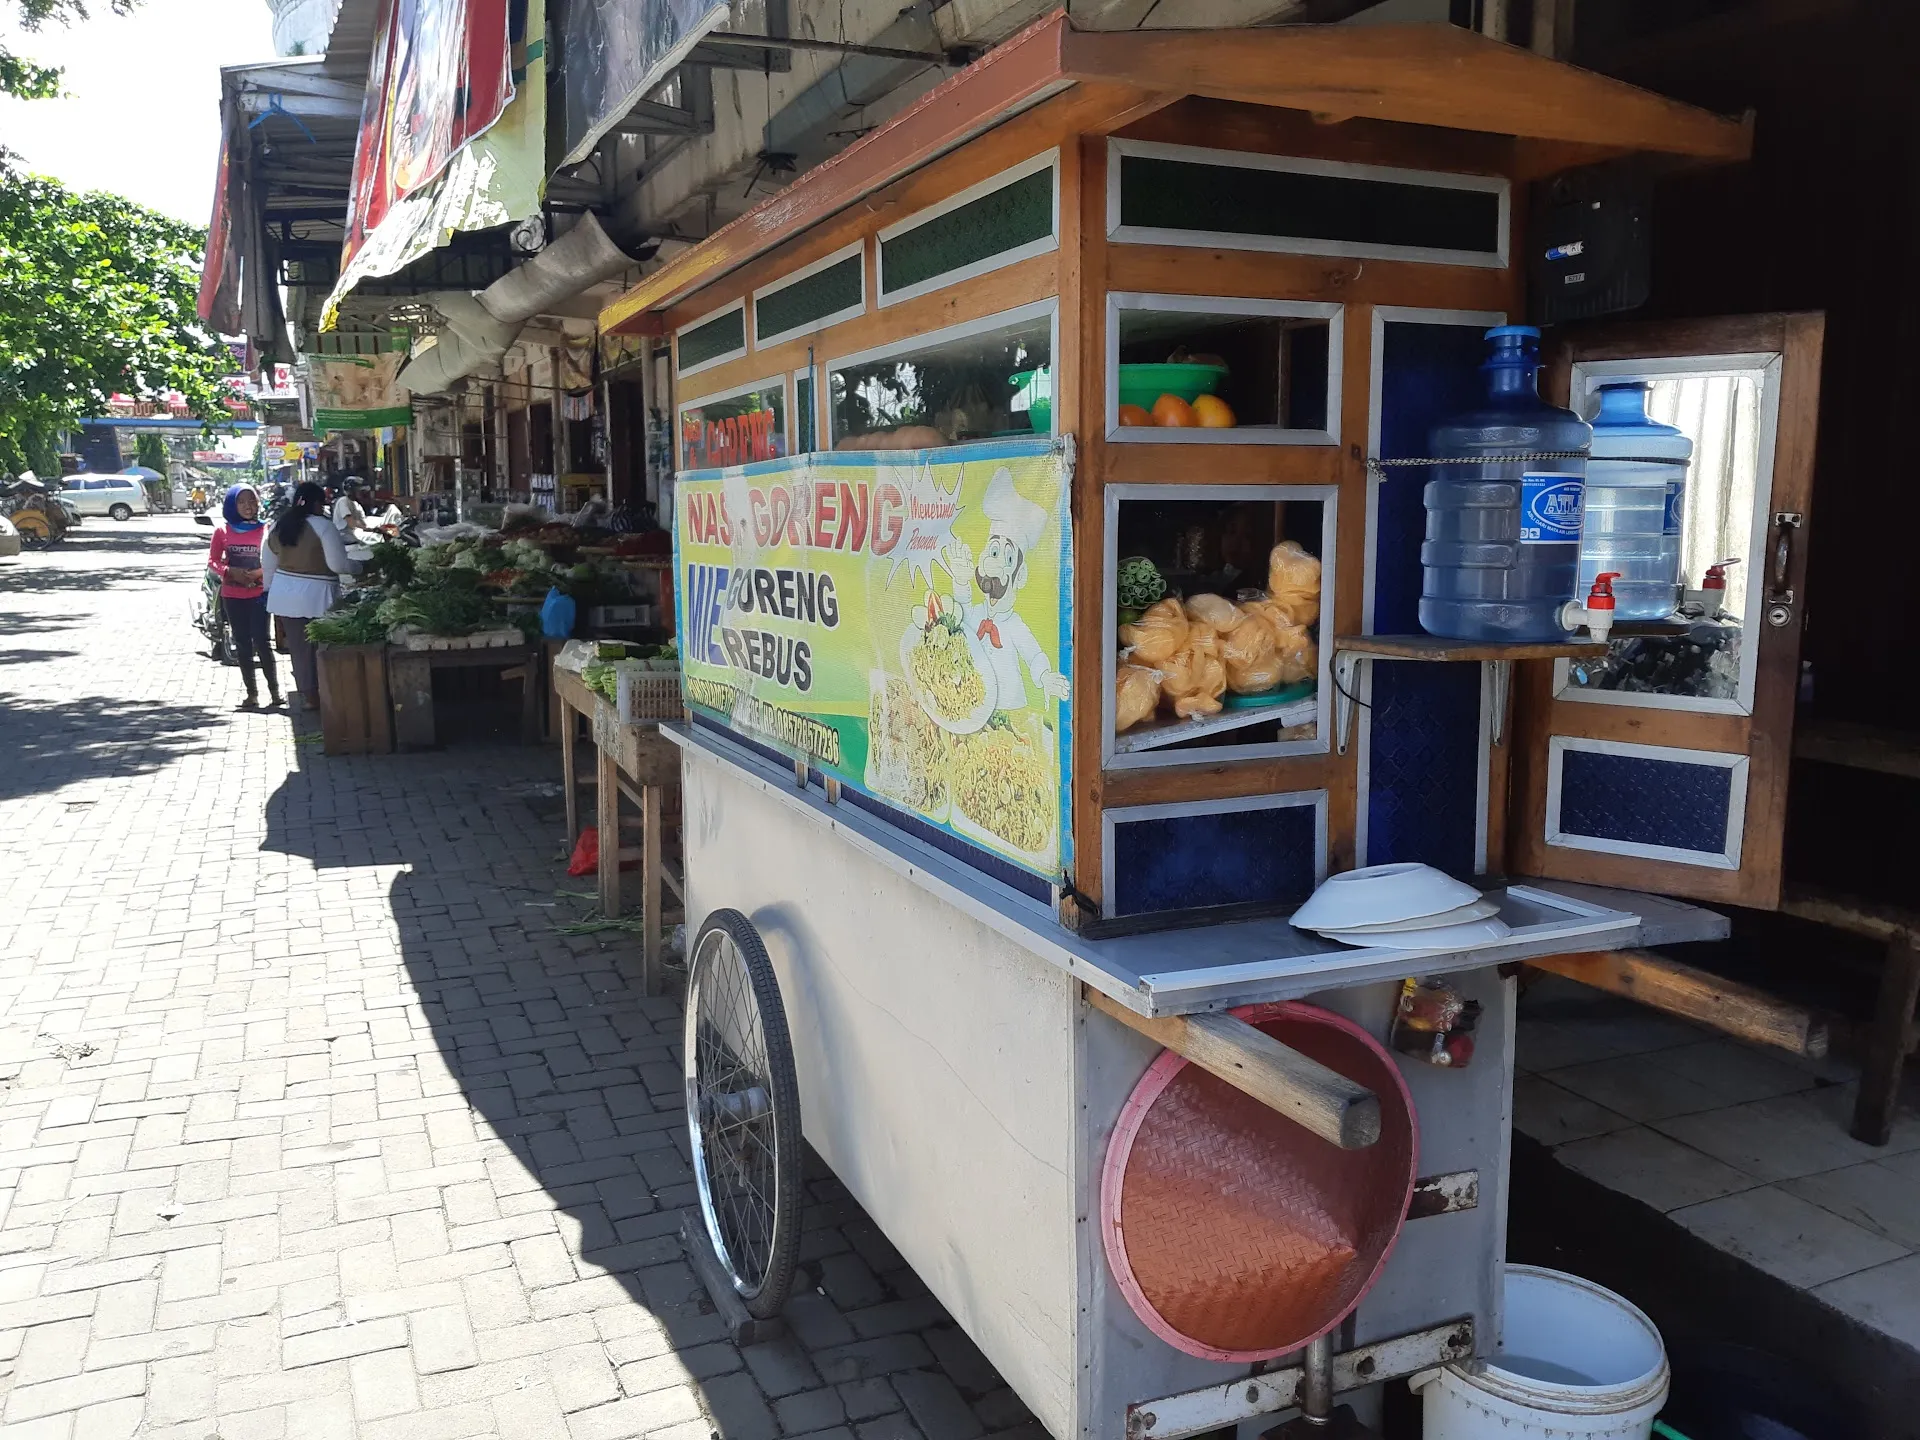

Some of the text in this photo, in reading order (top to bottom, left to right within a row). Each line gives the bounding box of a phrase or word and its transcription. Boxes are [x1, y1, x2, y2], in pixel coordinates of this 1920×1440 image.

[749, 483, 904, 556] GORENG
[688, 564, 840, 667] MIE GORENG
[721, 627, 812, 692] REBUS
